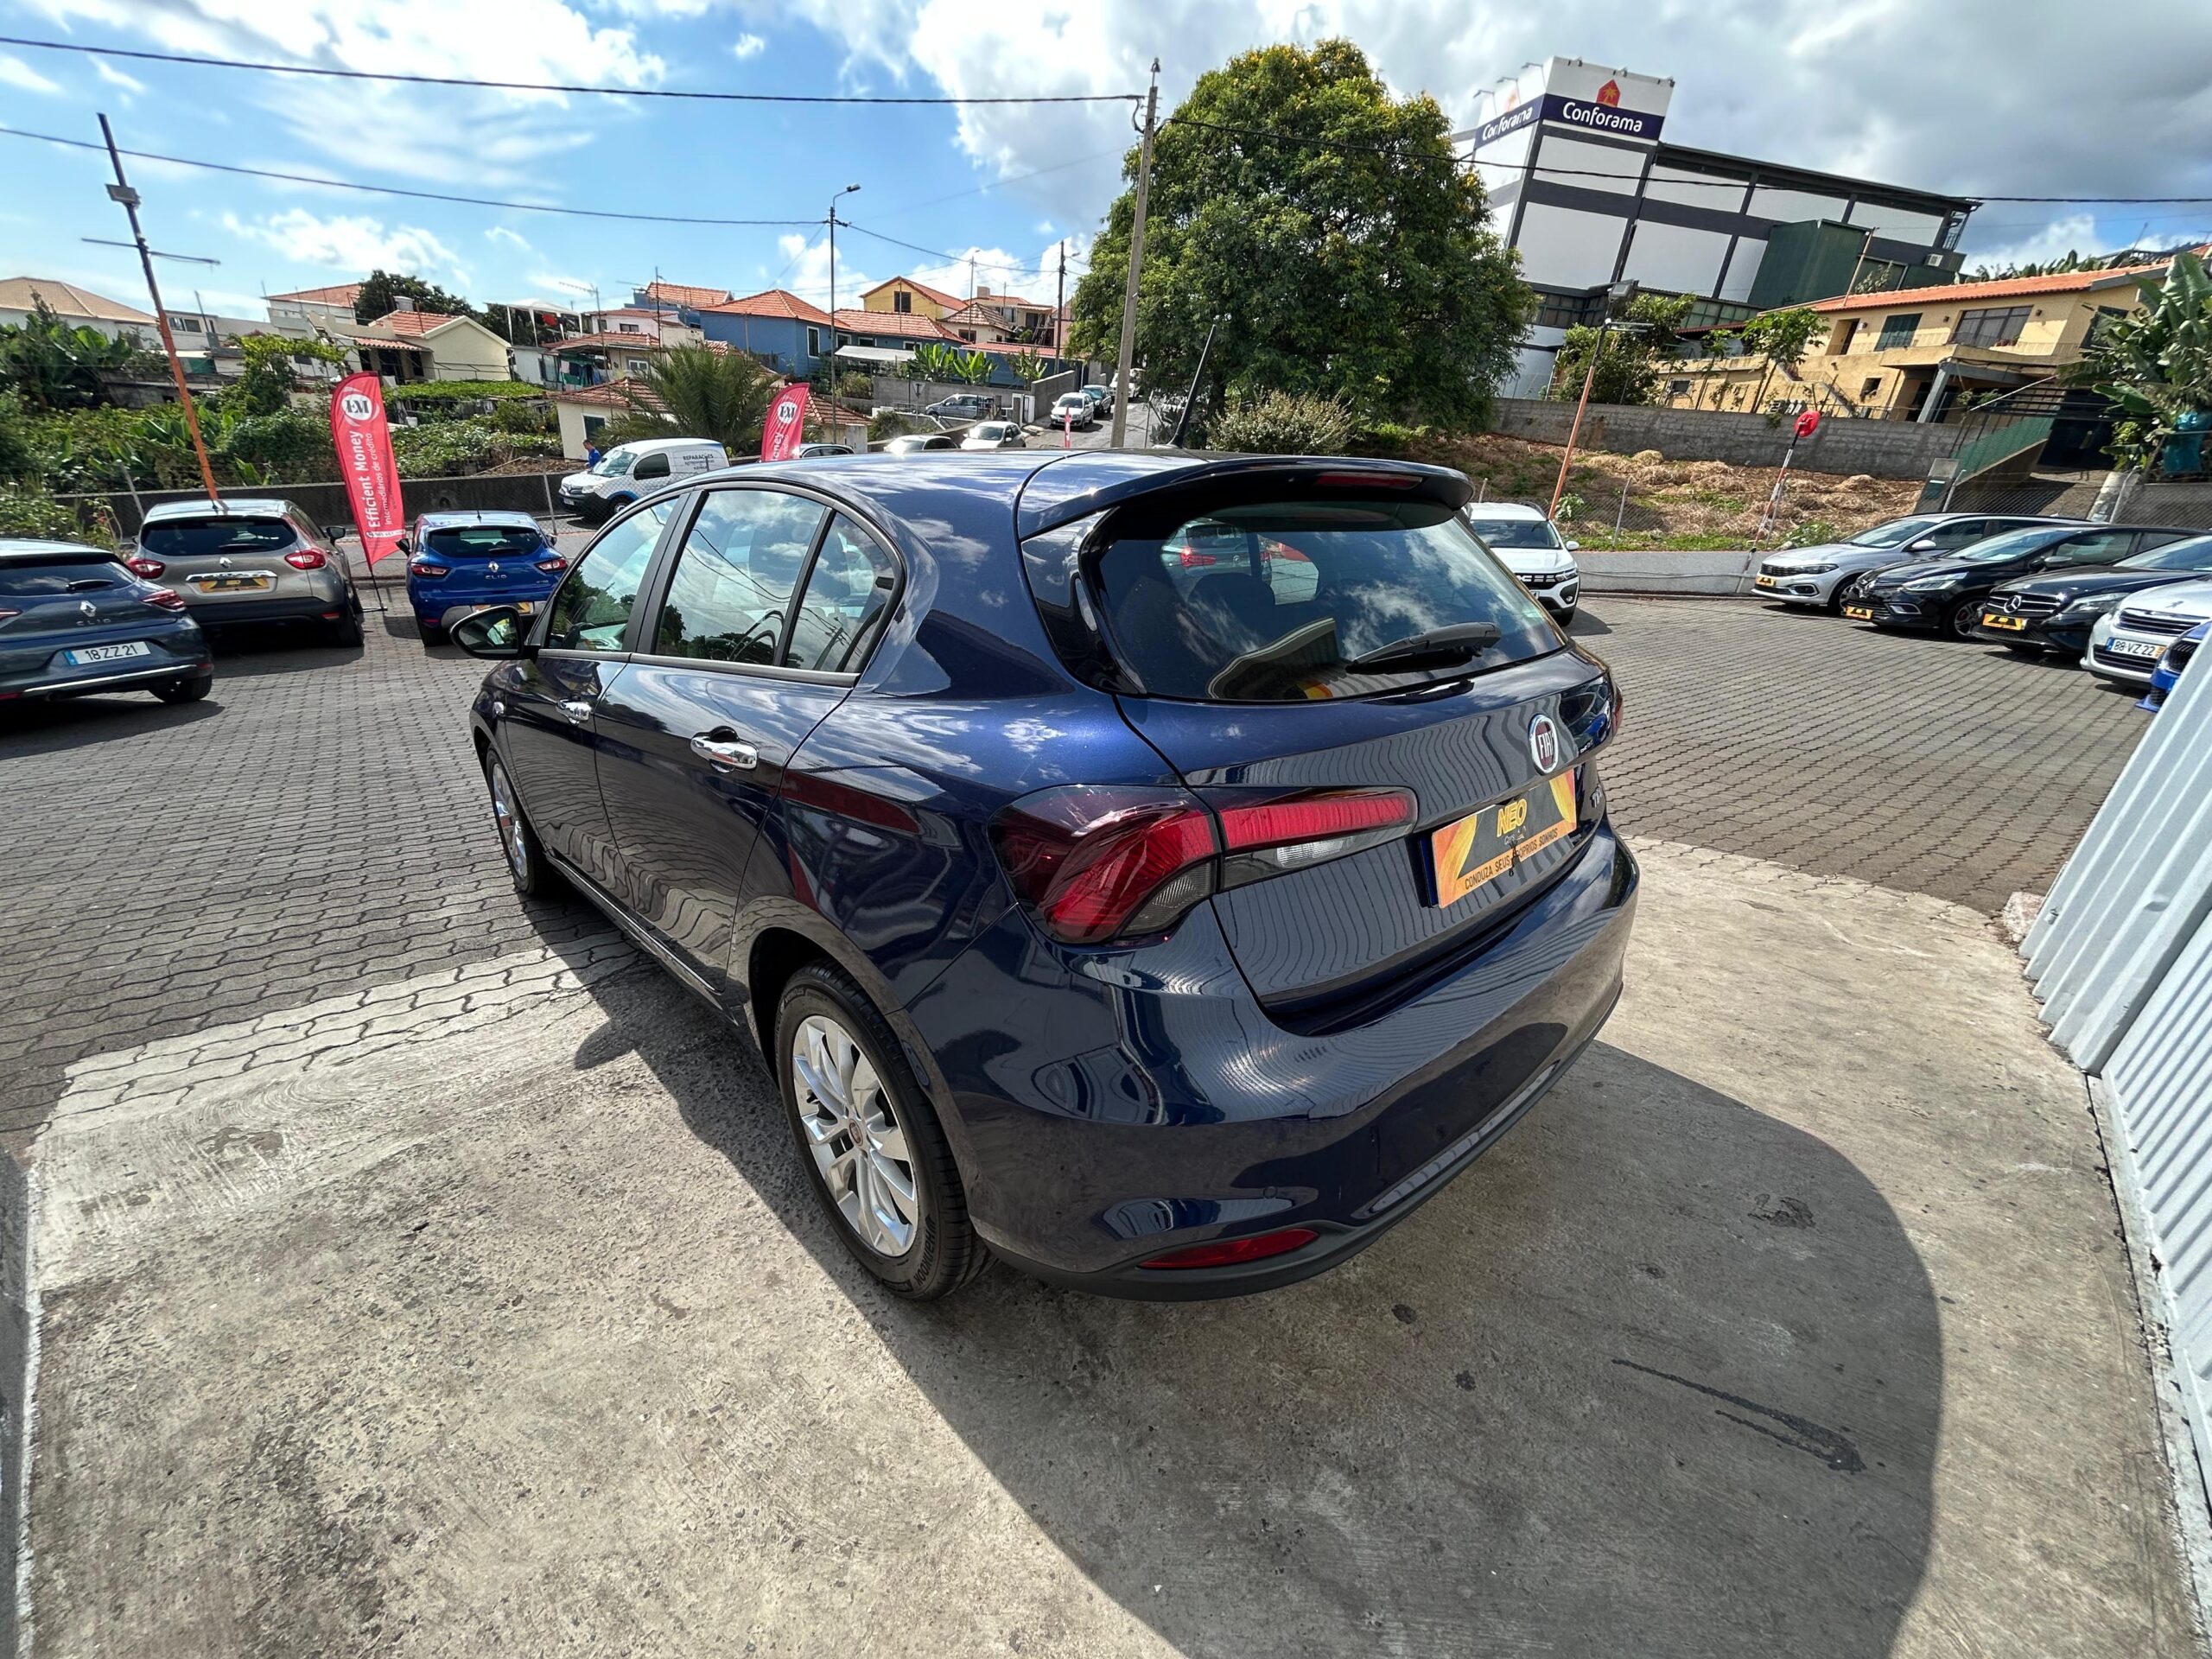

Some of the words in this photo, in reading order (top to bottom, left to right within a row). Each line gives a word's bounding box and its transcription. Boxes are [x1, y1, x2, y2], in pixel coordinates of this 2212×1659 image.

[1482, 106, 1533, 141] Conforama
[1562, 101, 1643, 133] Conforama
[349, 430, 369, 472] Money
[365, 433, 378, 460] crédito
[771, 432, 785, 461] oney
[372, 461, 381, 472] de
[358, 476, 381, 528] Efficient
[76, 618, 111, 626] CLIO
[1537, 730, 1554, 760] FIAT
[1496, 798, 1528, 837] NEO
[1465, 865, 1494, 890] CONDUZA
[1494, 855, 1510, 874] SEUS
[1539, 827, 1559, 847] SONHOS
